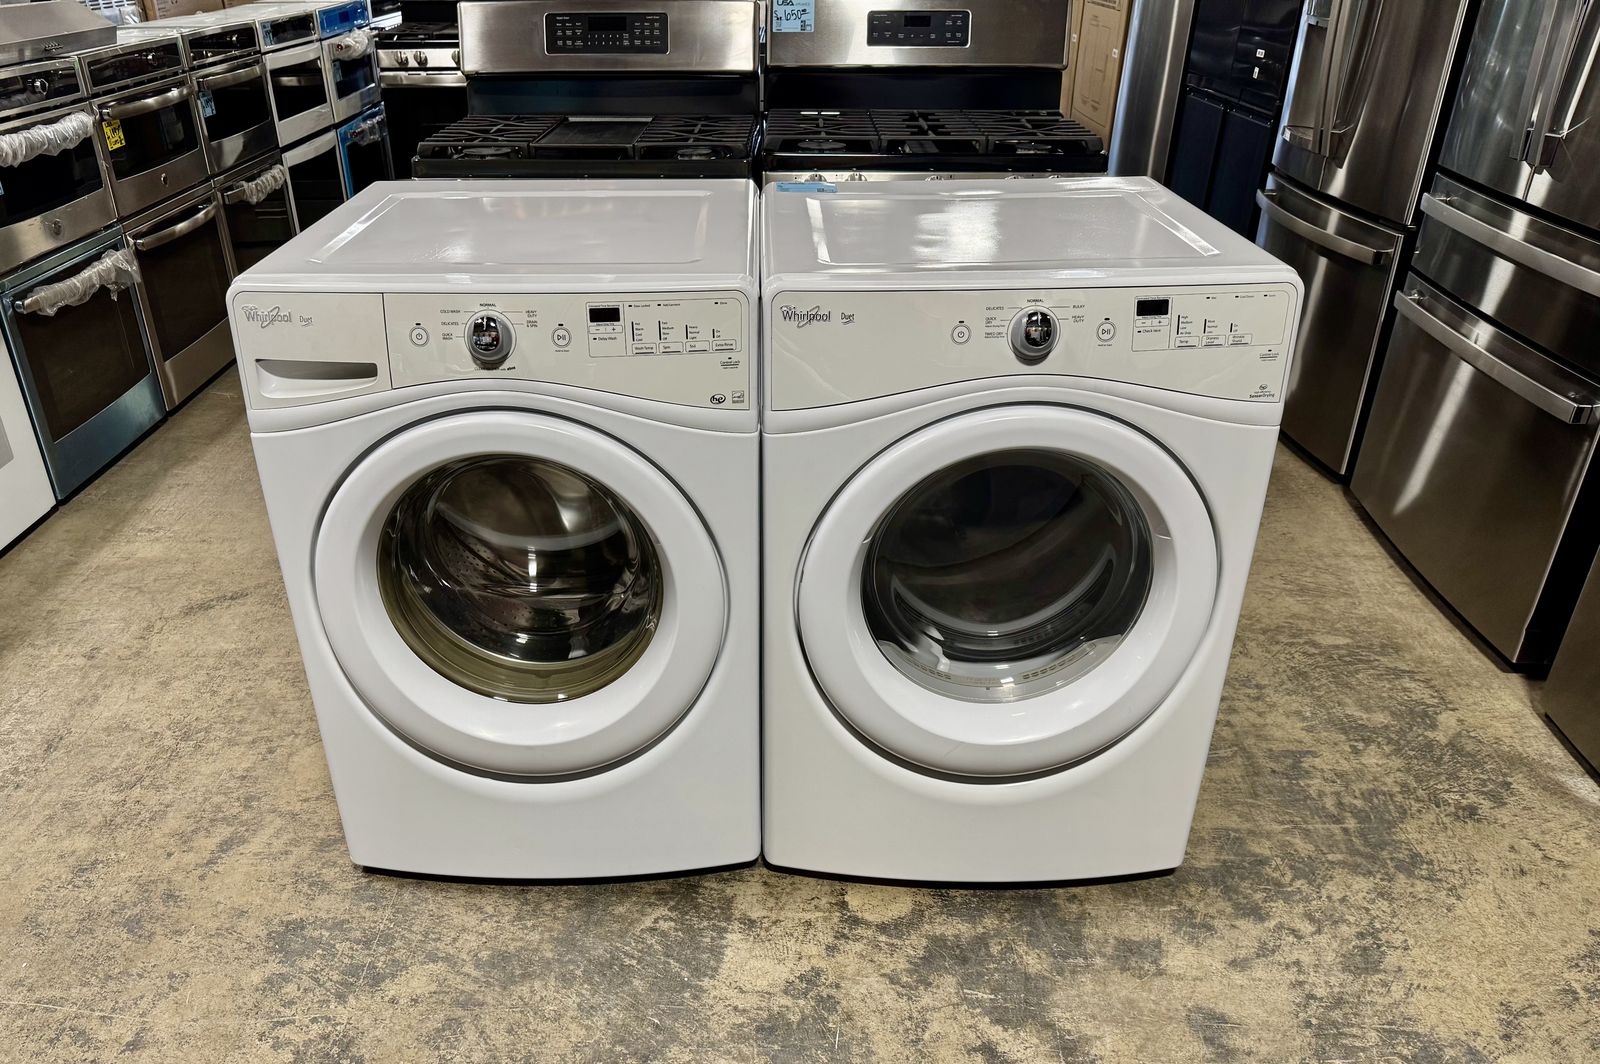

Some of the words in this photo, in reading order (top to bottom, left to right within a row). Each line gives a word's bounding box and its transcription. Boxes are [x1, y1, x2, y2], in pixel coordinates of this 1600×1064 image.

[243, 308, 293, 327] Whirlpool
[781, 307, 830, 326] Whirlpool
[840, 312, 855, 322] Duet
